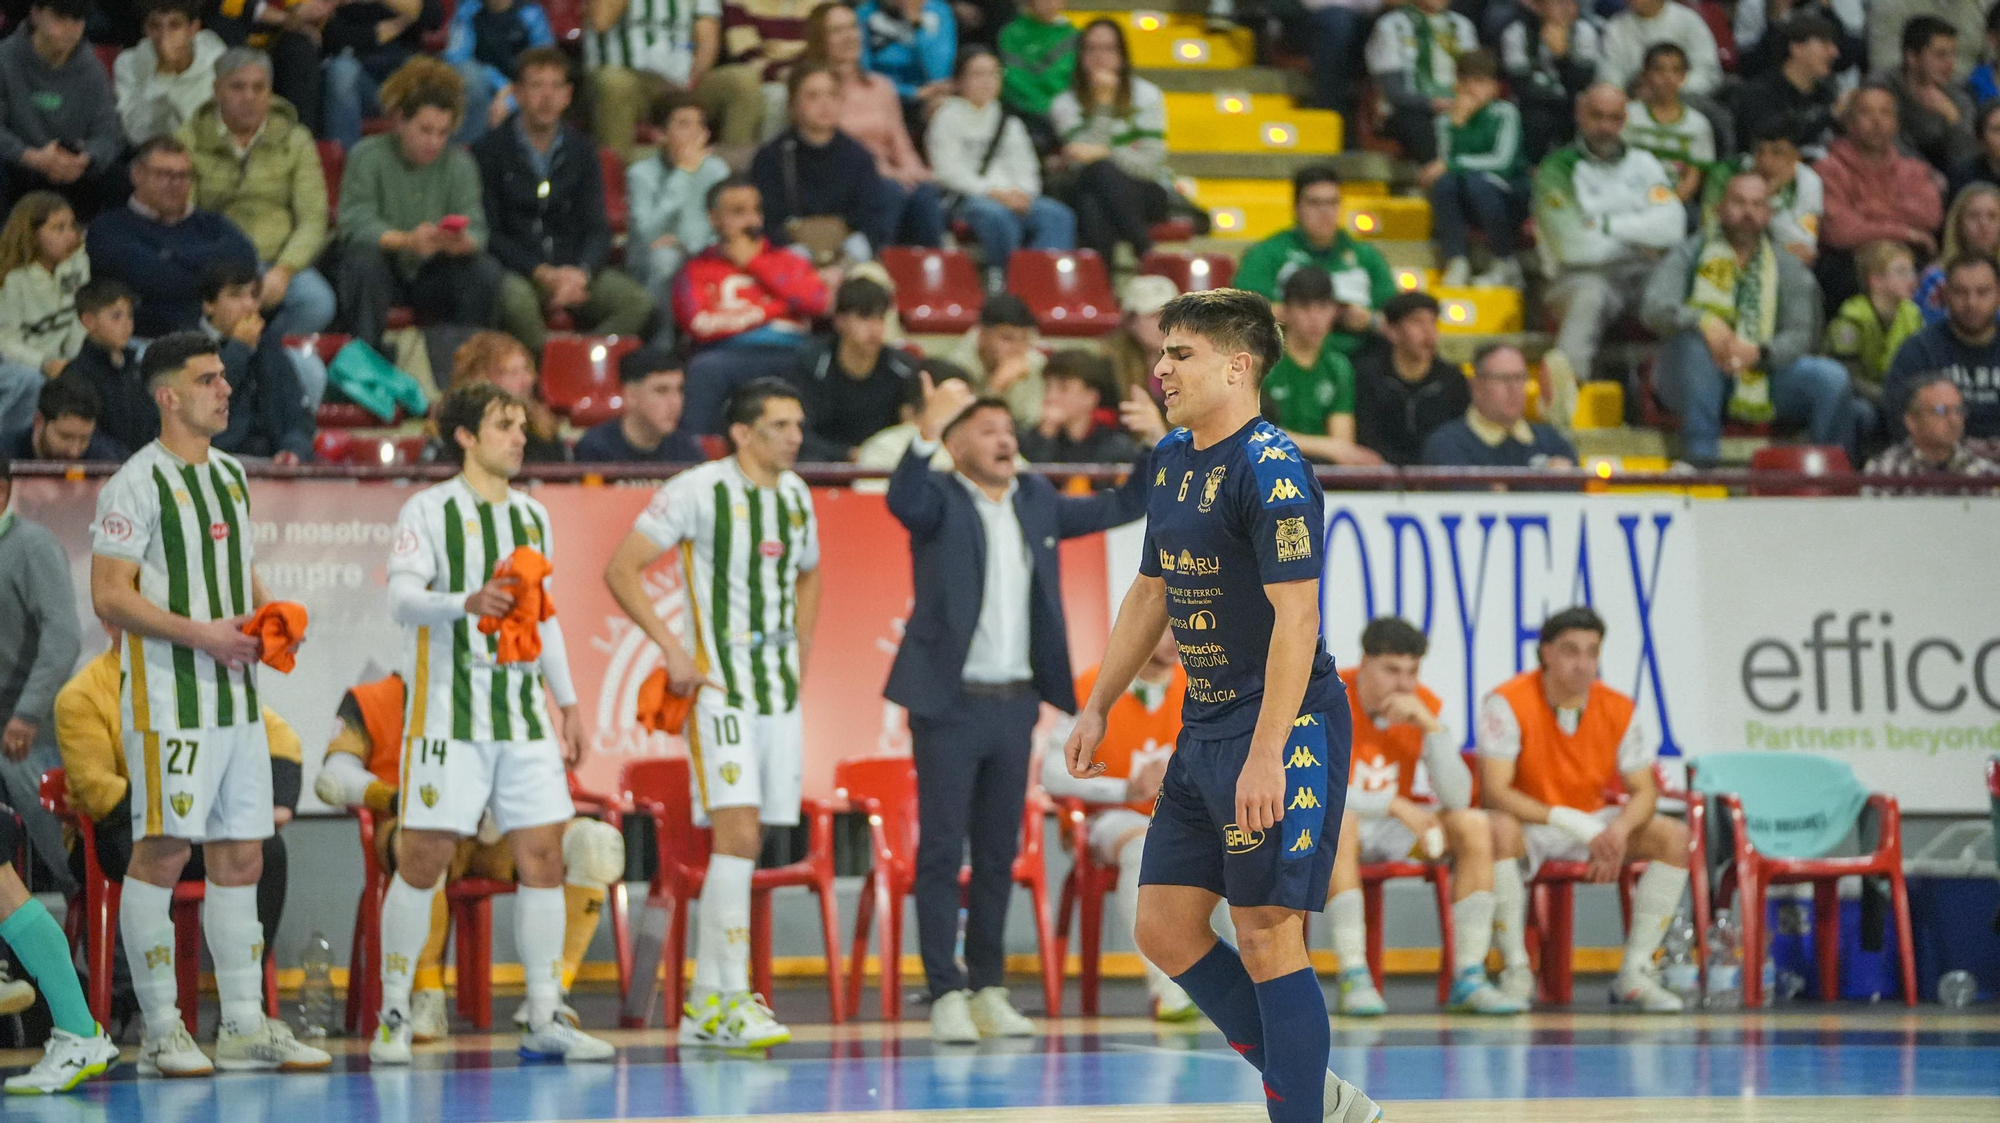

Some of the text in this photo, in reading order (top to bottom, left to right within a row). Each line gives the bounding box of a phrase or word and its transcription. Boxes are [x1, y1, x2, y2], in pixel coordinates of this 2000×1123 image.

[1178, 470, 1194, 502] 6
[1193, 587, 1224, 598] FERROL
[1176, 639, 1225, 656] Deputación
[1189, 653, 1229, 668] CORUÑA
[713, 713, 740, 747] 10
[1745, 719, 1875, 750] Partners
[166, 738, 199, 776] 27
[421, 738, 447, 766] 14
